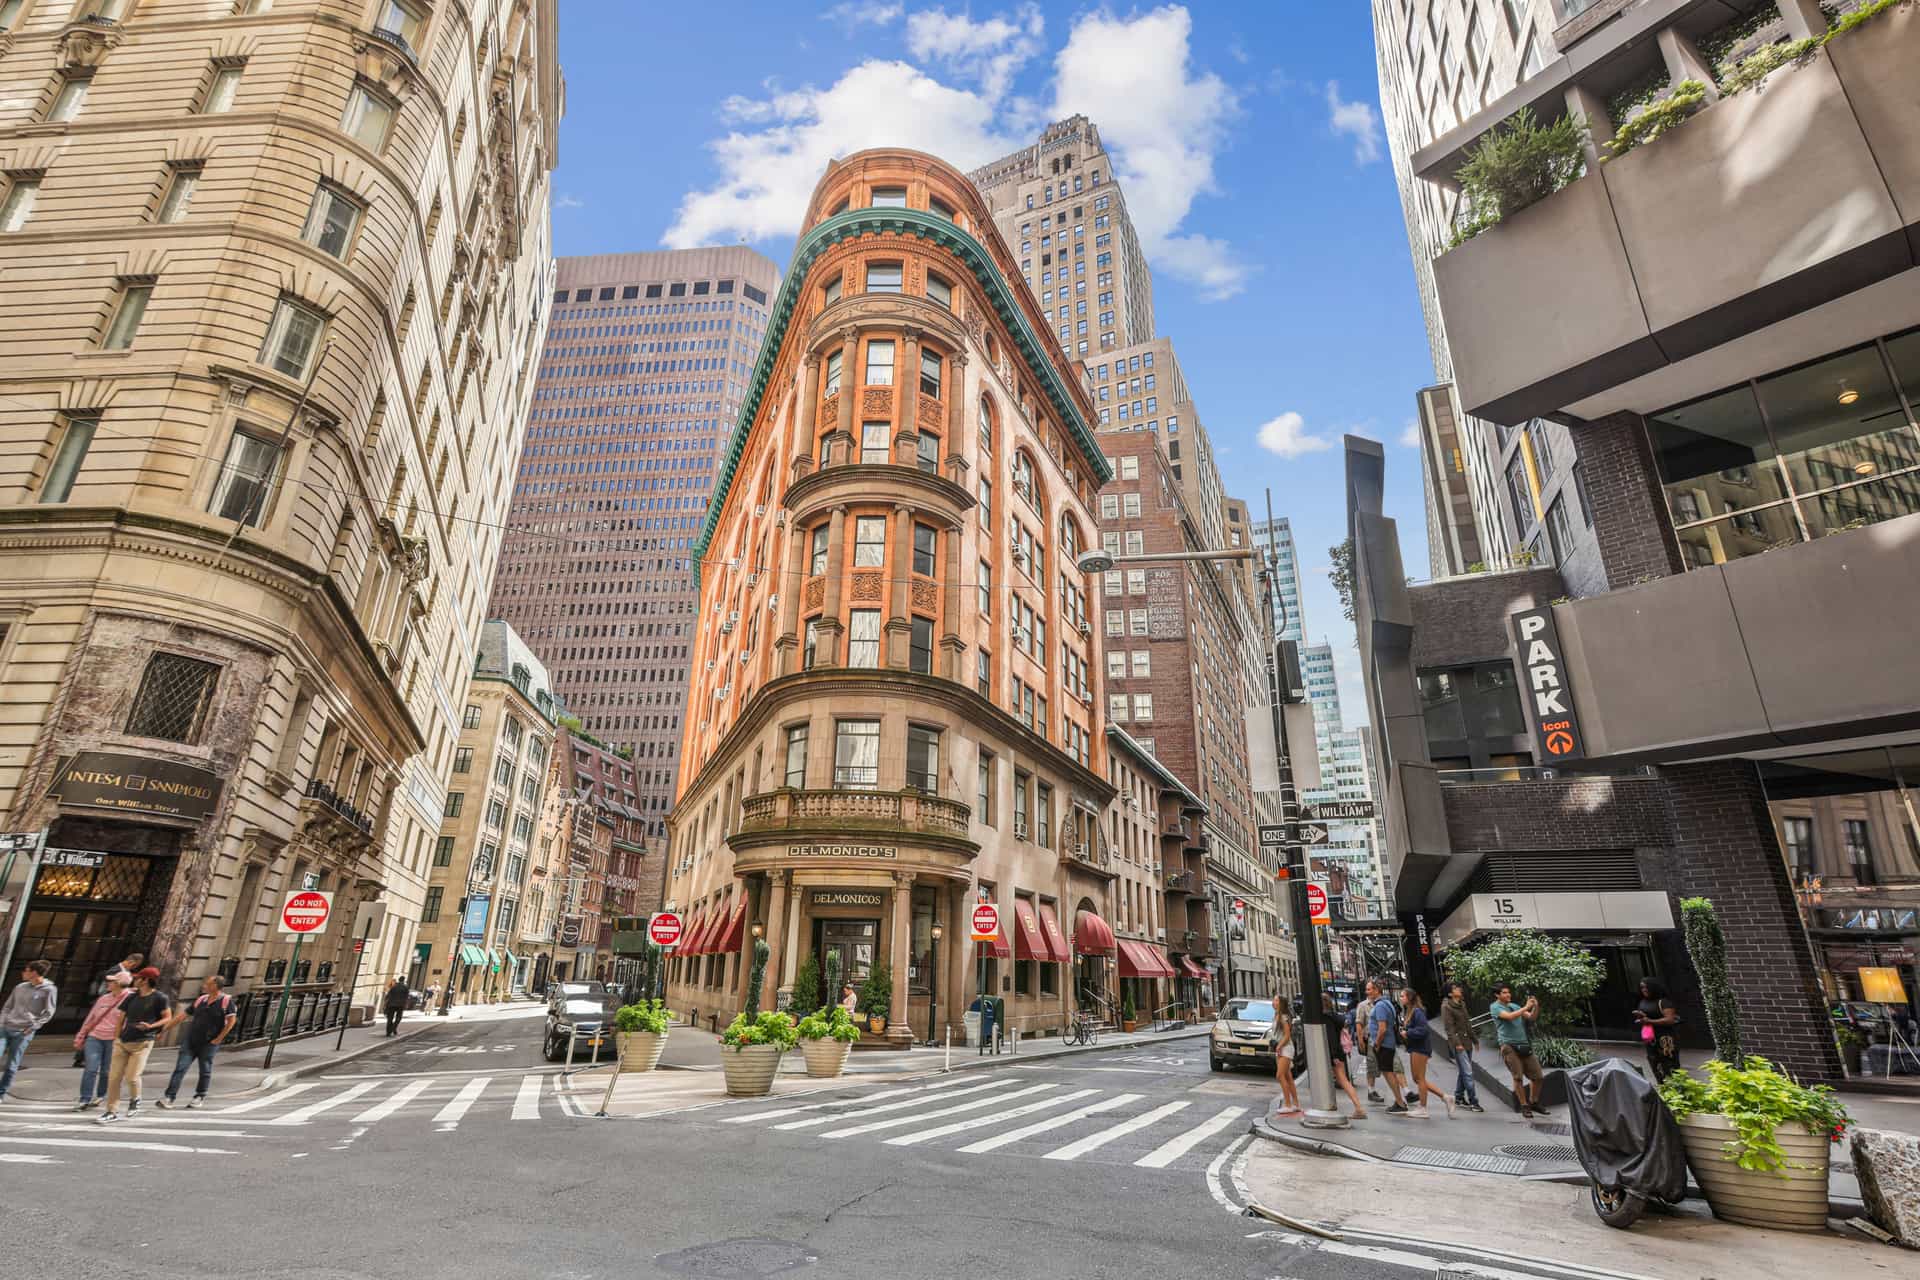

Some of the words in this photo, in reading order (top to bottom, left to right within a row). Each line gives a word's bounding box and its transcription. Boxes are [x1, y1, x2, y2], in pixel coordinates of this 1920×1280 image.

[1520, 615, 1568, 716] PARK
[67, 771, 121, 786] INTESA
[148, 779, 211, 799] SANPAOLO
[95, 797, 114, 805] One
[1321, 806, 1364, 817] WILLIAM
[1264, 831, 1286, 840] ONE
[790, 846, 894, 857] DELMONICO'S
[814, 894, 881, 904] DELMONICOS
[1494, 899, 1514, 914] 15
[291, 917, 318, 925] ENTER
[1416, 914, 1428, 944] PARK
